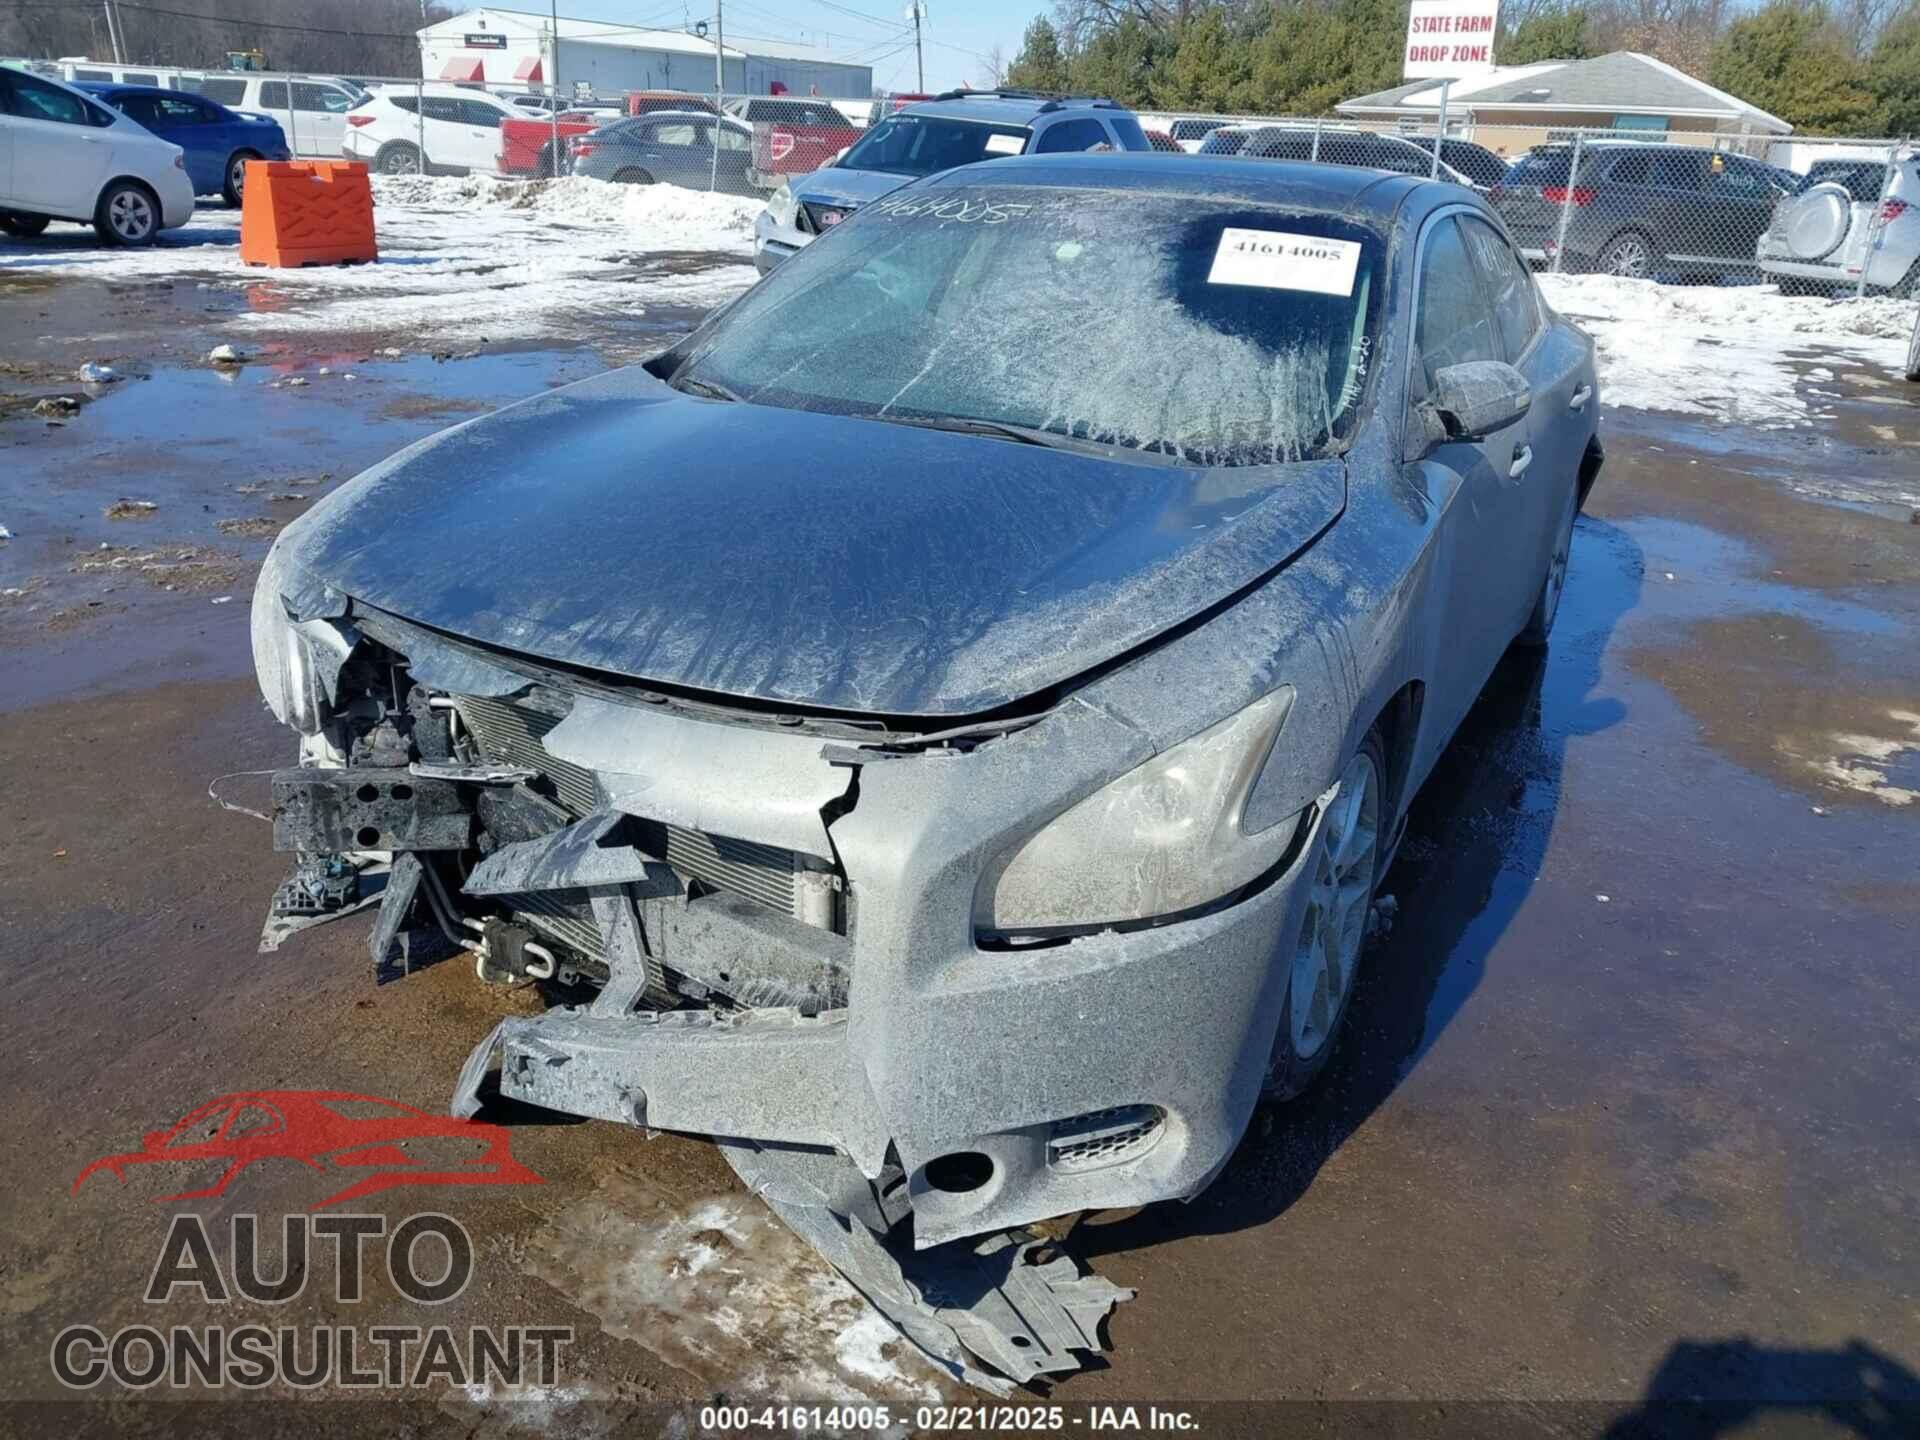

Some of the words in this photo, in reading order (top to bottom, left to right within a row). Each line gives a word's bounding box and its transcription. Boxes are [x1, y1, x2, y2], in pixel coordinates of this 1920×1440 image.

[1412, 15, 1451, 33] STATE
[1454, 15, 1493, 33] FARM
[1409, 45, 1449, 62] DROP
[1451, 45, 1489, 62] ZONE
[1233, 241, 1342, 262] 41614005
